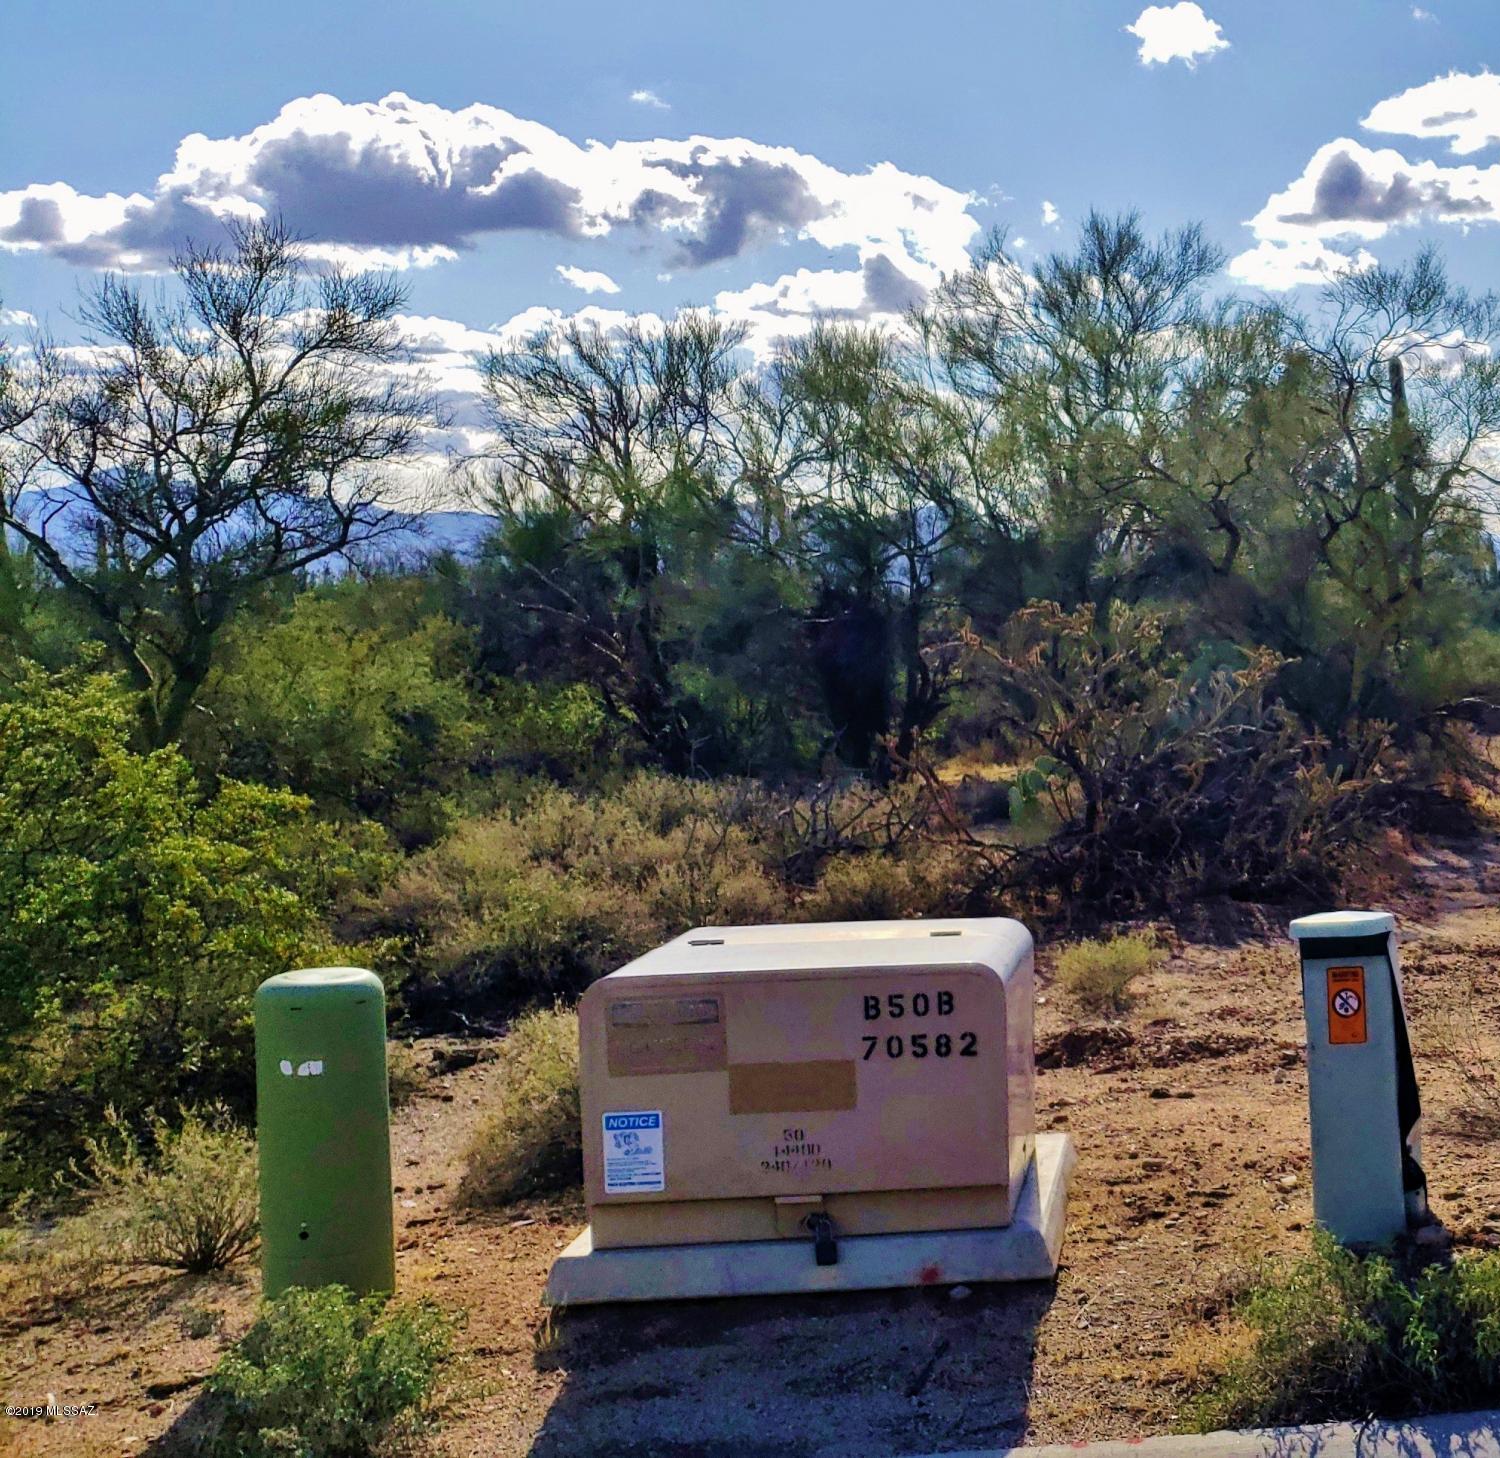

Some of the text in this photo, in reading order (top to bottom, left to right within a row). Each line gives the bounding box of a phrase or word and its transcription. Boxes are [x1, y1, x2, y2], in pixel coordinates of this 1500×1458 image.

[863, 990, 954, 1020] B50B
[862, 1031, 978, 1060] 70582
[608, 1116, 657, 1128] NOTICE
